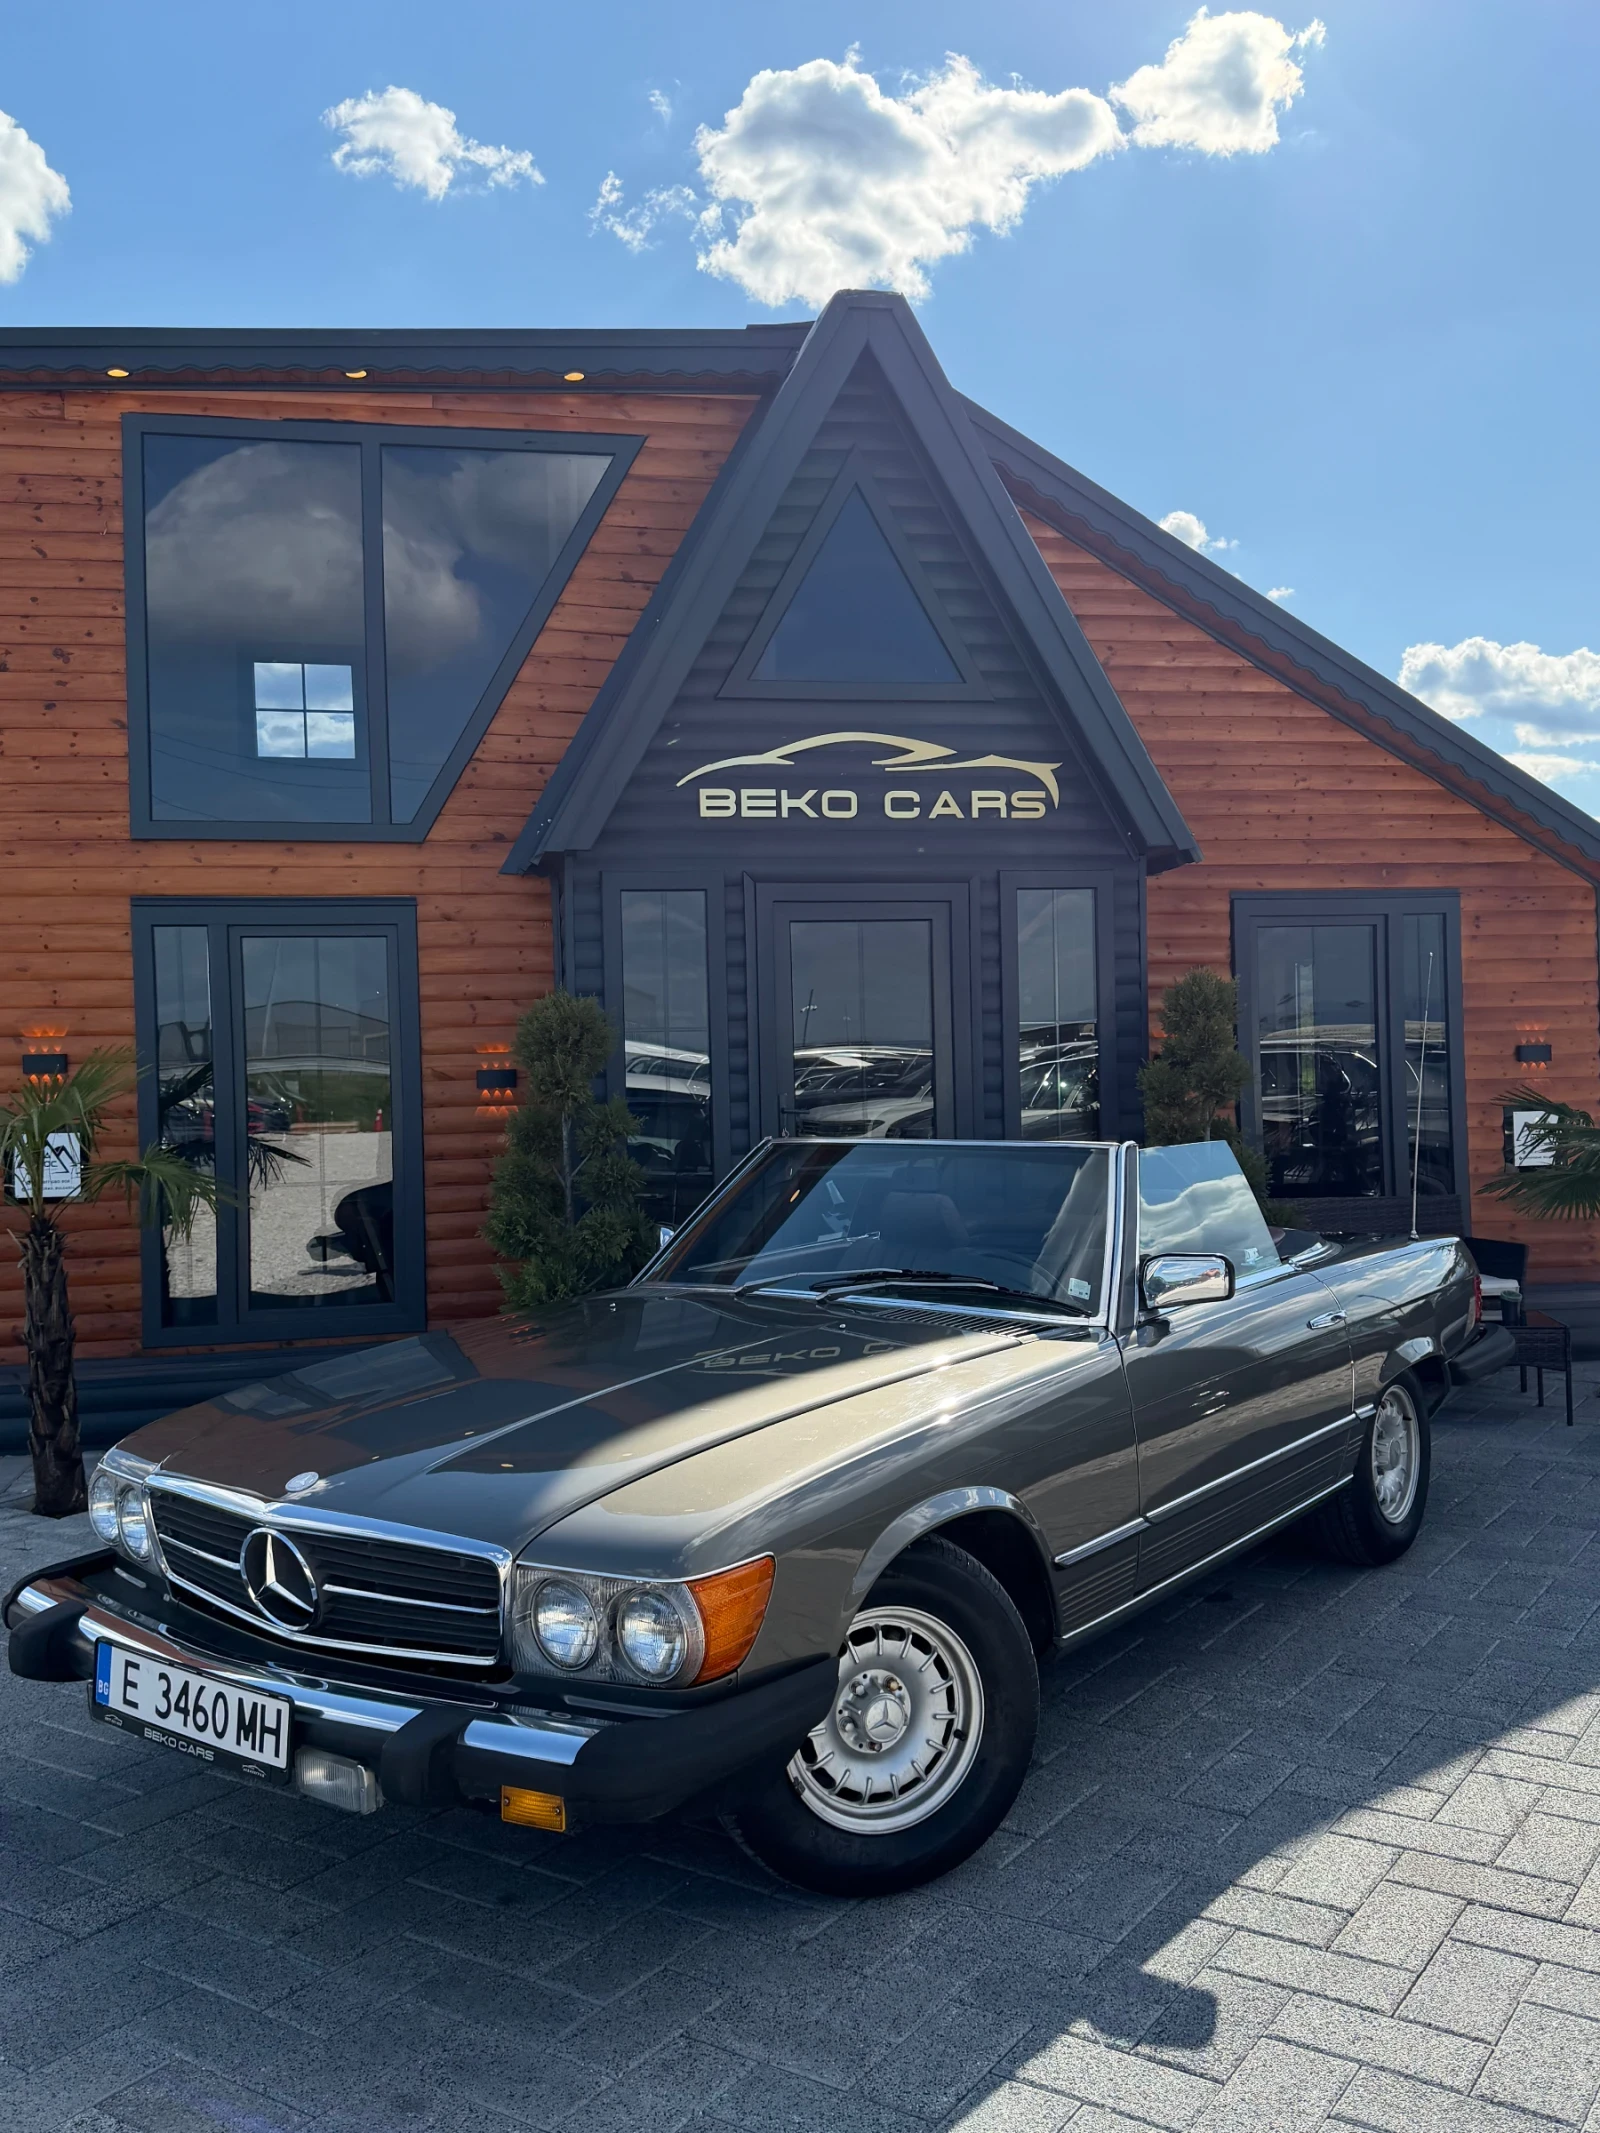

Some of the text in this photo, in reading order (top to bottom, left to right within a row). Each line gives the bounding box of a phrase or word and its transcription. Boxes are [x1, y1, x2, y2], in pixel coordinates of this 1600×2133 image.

[699, 788, 1046, 819] BEKO CARS
[98, 1680, 109, 1695] BG
[123, 1659, 282, 1759] E 3460 MH
[144, 1727, 215, 1761] BEKO CARS
